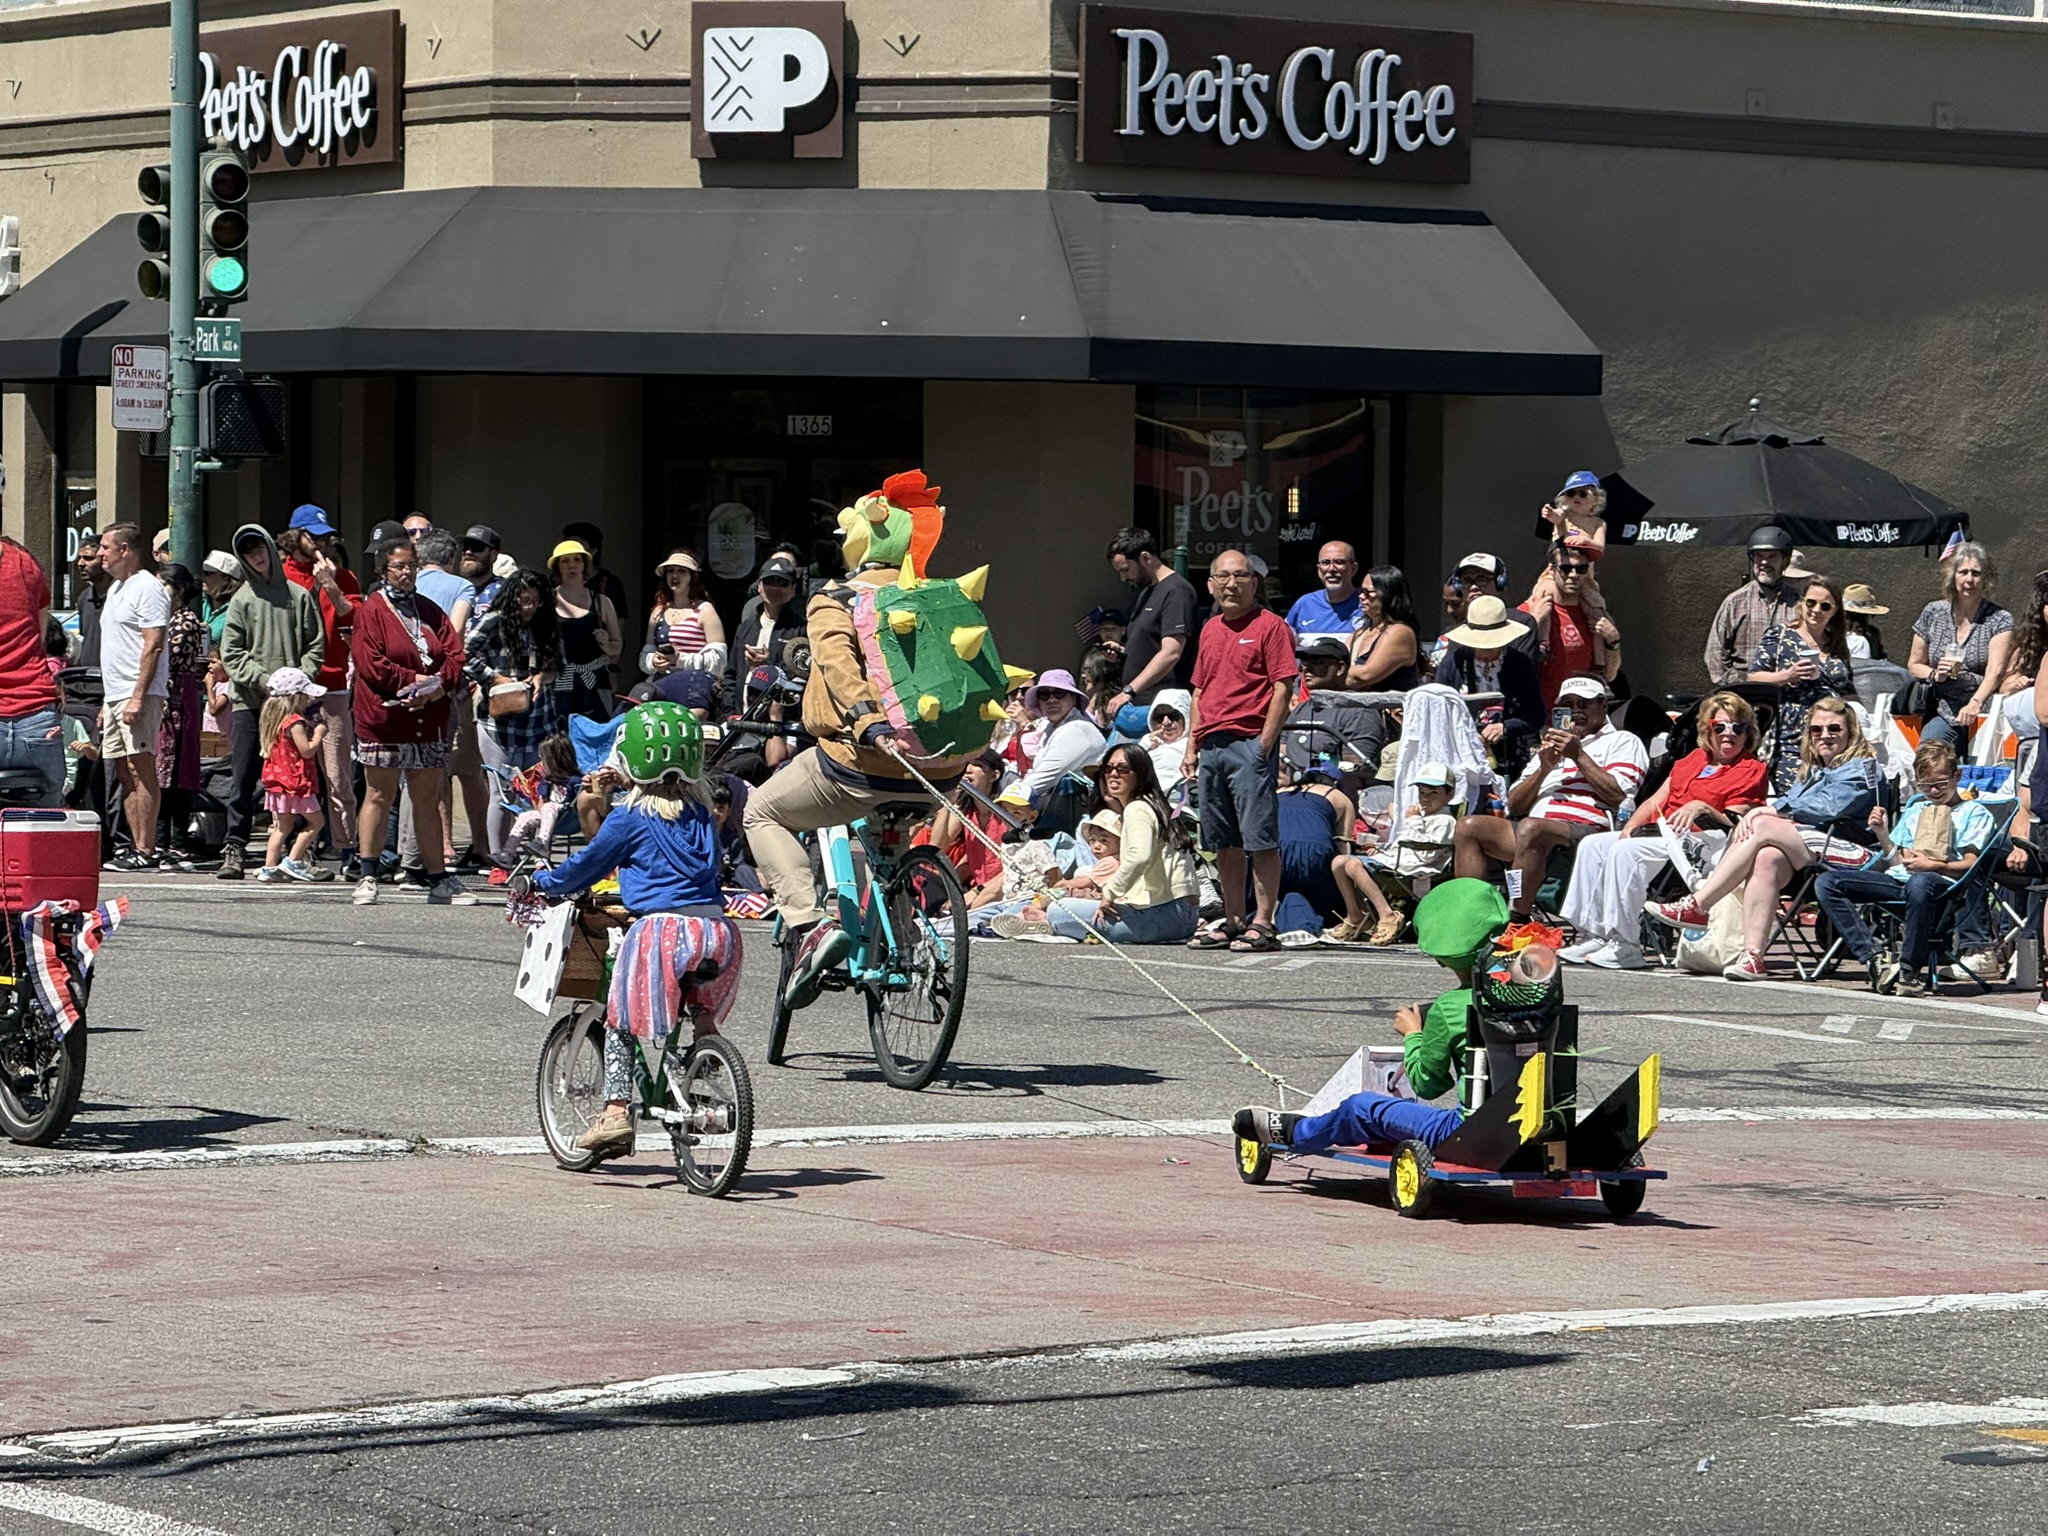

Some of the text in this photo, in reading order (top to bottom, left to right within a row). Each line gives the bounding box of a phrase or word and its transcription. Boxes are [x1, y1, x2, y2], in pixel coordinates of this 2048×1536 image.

[704, 27, 829, 132] P
[271, 39, 370, 154] Coffee
[1116, 28, 1456, 165] Peet's Coffee
[196, 326, 219, 352] Park
[115, 348, 133, 365] NO
[115, 379, 166, 390] STREET SWEEPING
[118, 368, 162, 380] PARKING
[790, 416, 831, 435] 1365
[1176, 466, 1273, 537] Peet's
[1637, 521, 1666, 541] Peet's
[1666, 522, 1699, 543] Coffee
[1847, 522, 1873, 543] Peet's
[1872, 522, 1900, 544] Coffee
